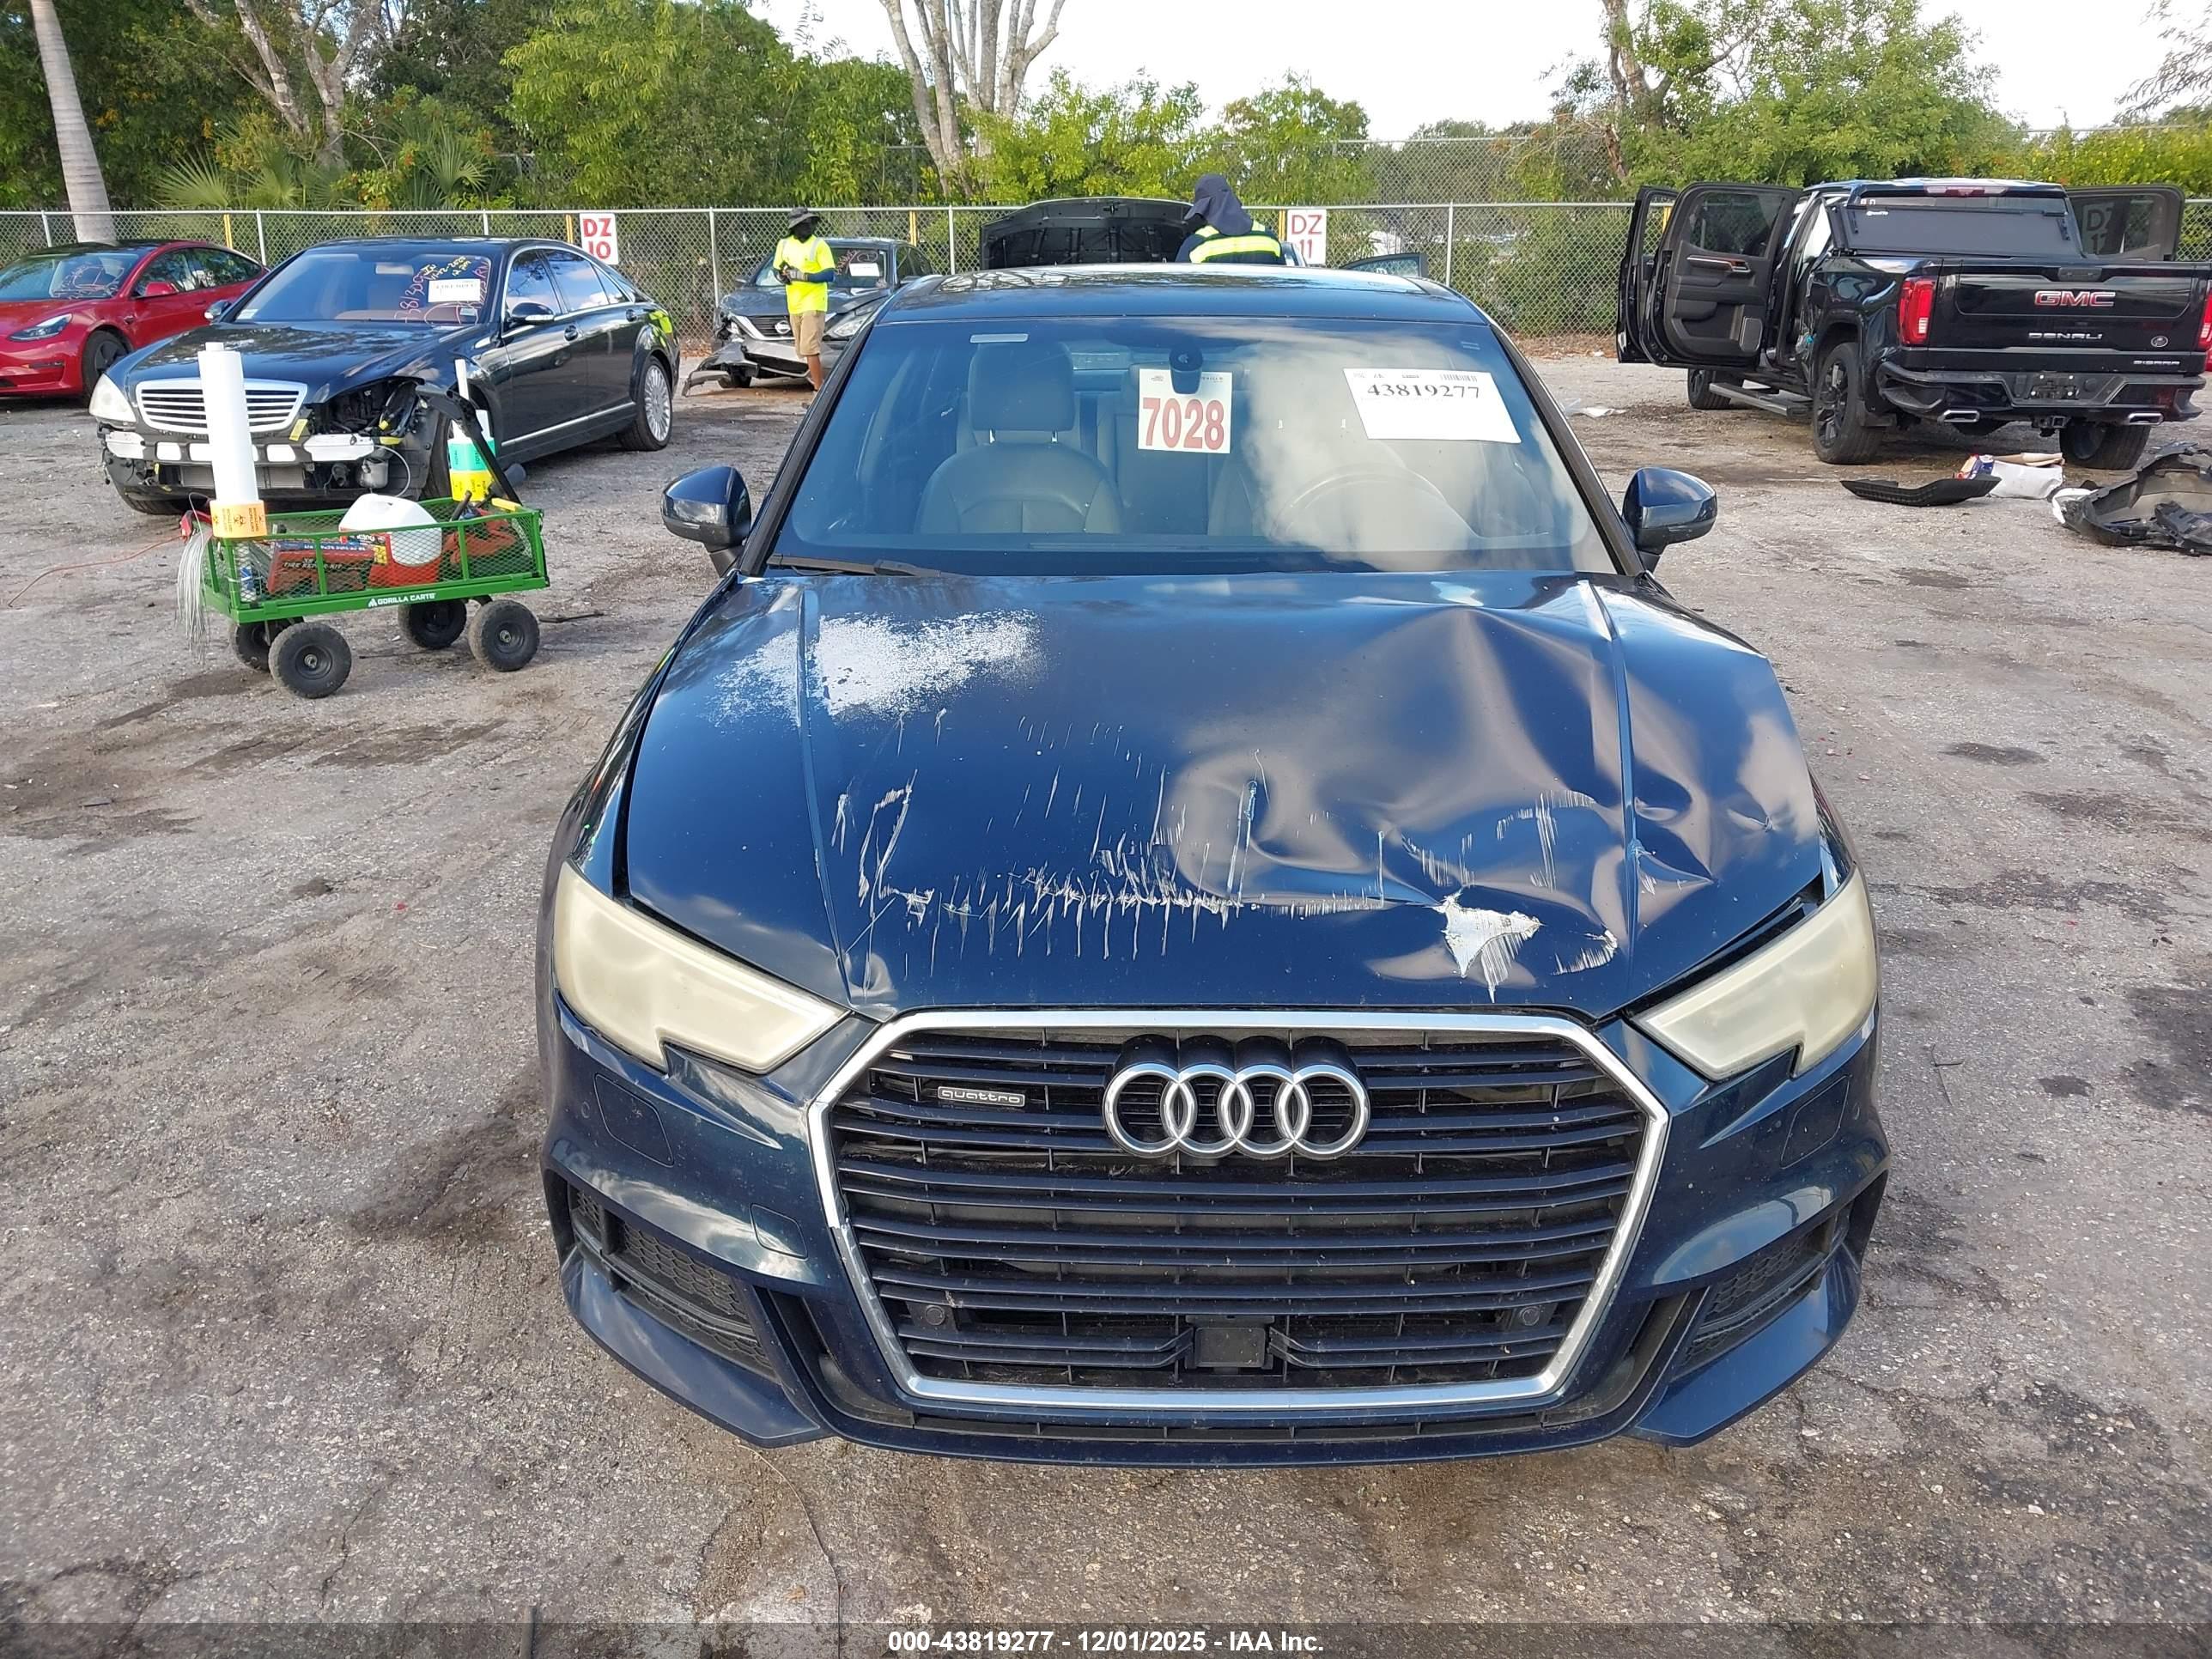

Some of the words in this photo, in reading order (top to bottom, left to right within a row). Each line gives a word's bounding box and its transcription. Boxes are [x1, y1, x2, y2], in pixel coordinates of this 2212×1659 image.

[582, 217, 612, 238] DZ
[1291, 215, 1322, 234] DZ
[1299, 239, 1313, 259] 11
[2034, 290, 2116, 307] GMC
[1367, 384, 1480, 399] 43819277
[1142, 397, 1225, 451] 7028
[377, 596, 409, 605] GORILLA
[941, 1090, 1021, 1104] quattro
